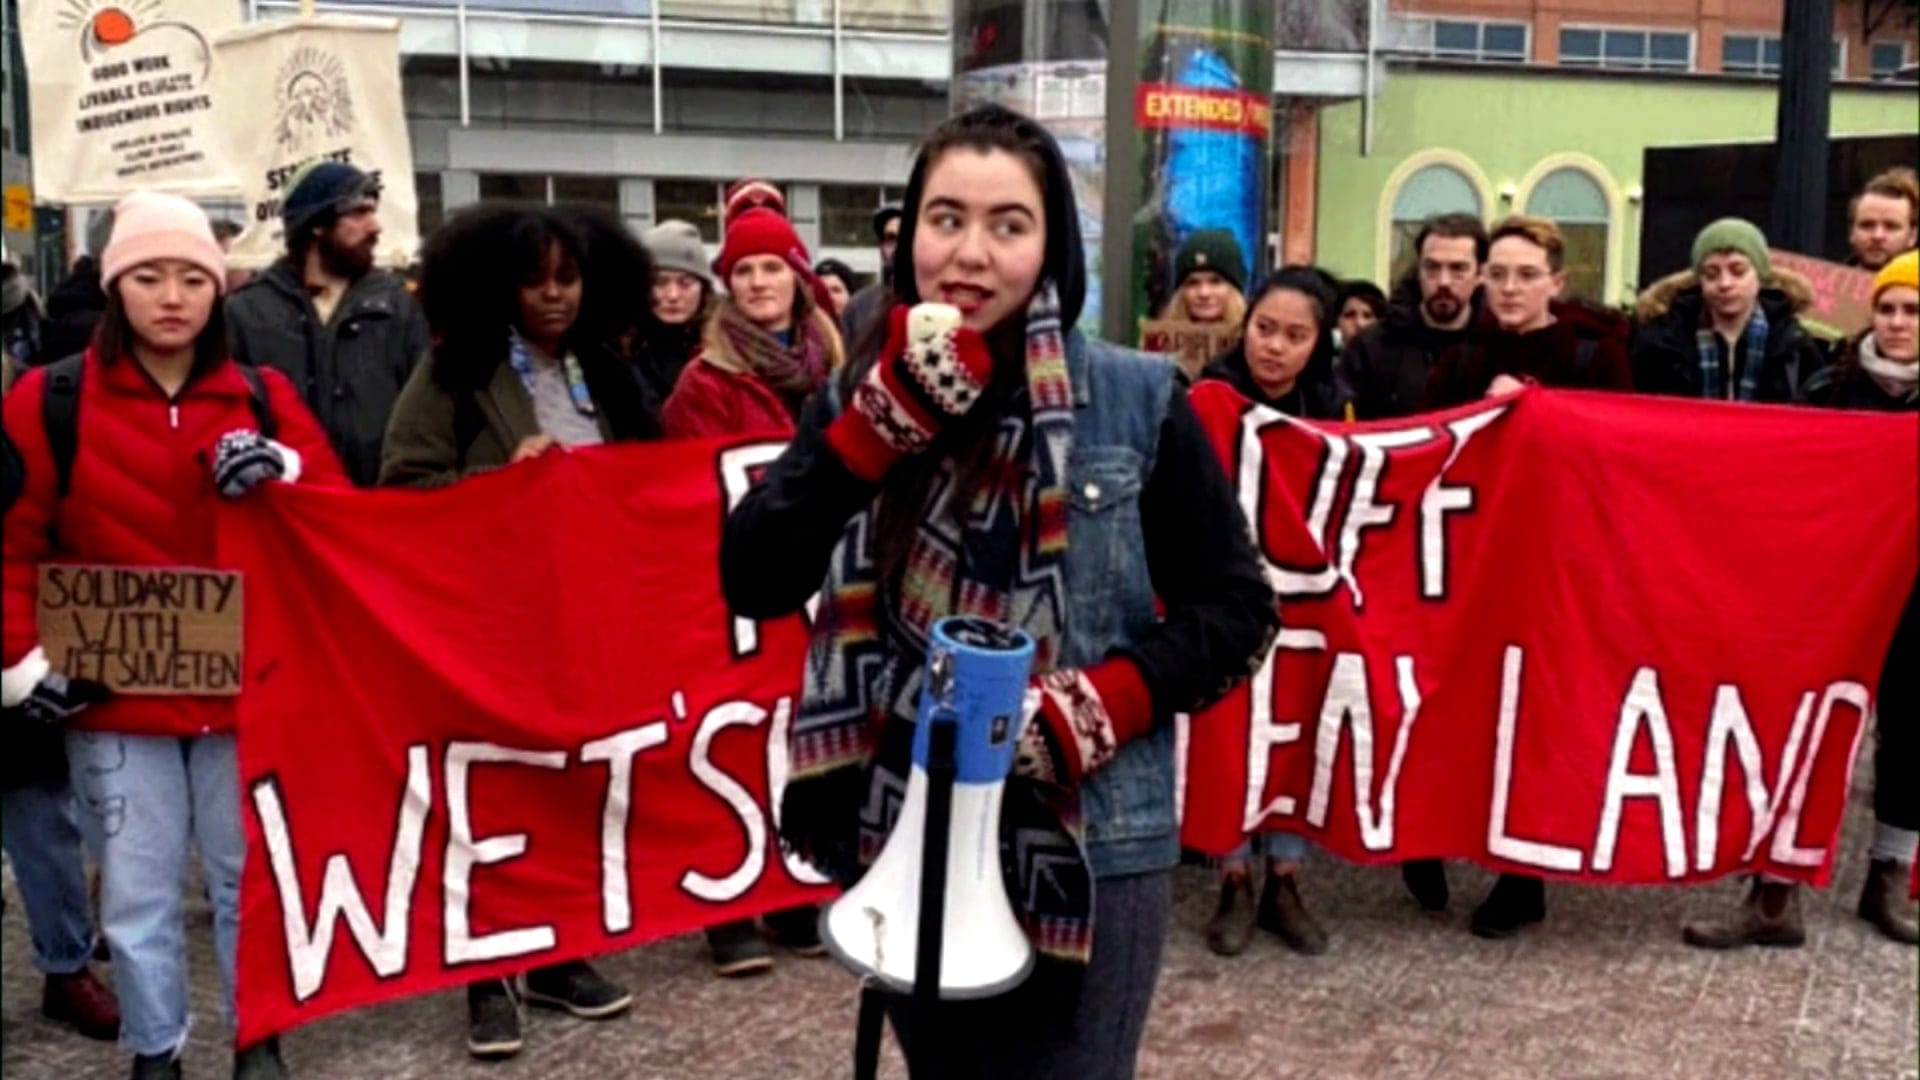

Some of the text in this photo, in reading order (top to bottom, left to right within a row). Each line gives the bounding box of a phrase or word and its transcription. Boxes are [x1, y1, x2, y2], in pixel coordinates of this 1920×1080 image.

[132, 55, 171, 73] WORK
[1146, 92, 1242, 122] EXTENDED
[42, 567, 236, 612] SOLIDARITY
[71, 609, 181, 650] WITH
[1487, 645, 1871, 878] LAND
